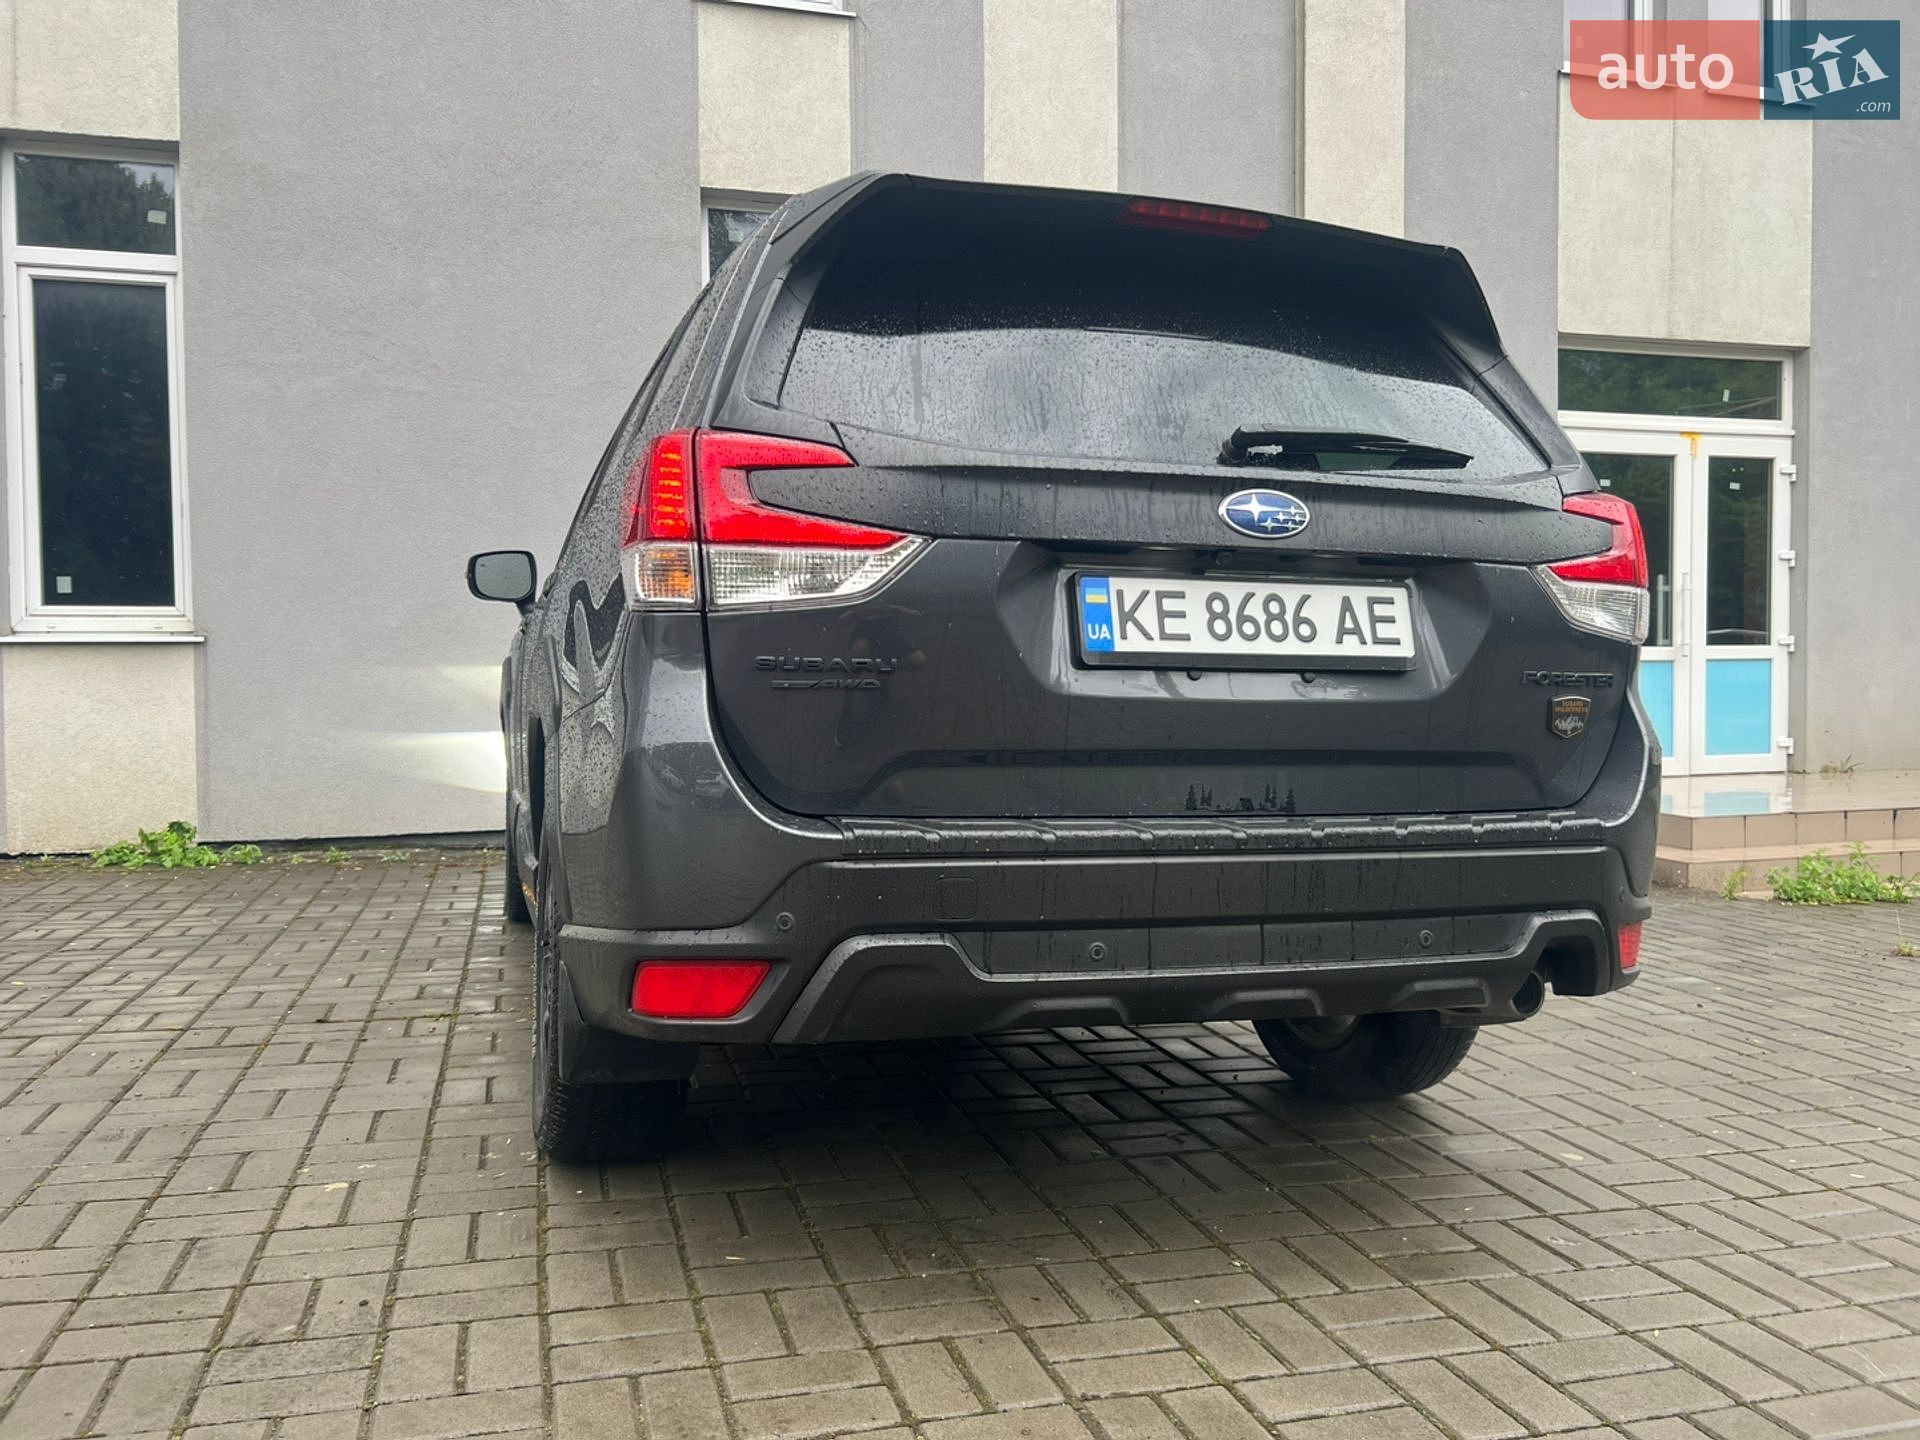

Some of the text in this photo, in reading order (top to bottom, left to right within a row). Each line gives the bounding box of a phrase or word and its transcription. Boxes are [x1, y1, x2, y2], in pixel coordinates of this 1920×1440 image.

[1116, 589, 1401, 645] KE 8686 AE
[1087, 624, 1111, 641] UA
[755, 655, 898, 672] SUBARU
[1522, 670, 1614, 688] FORESTER
